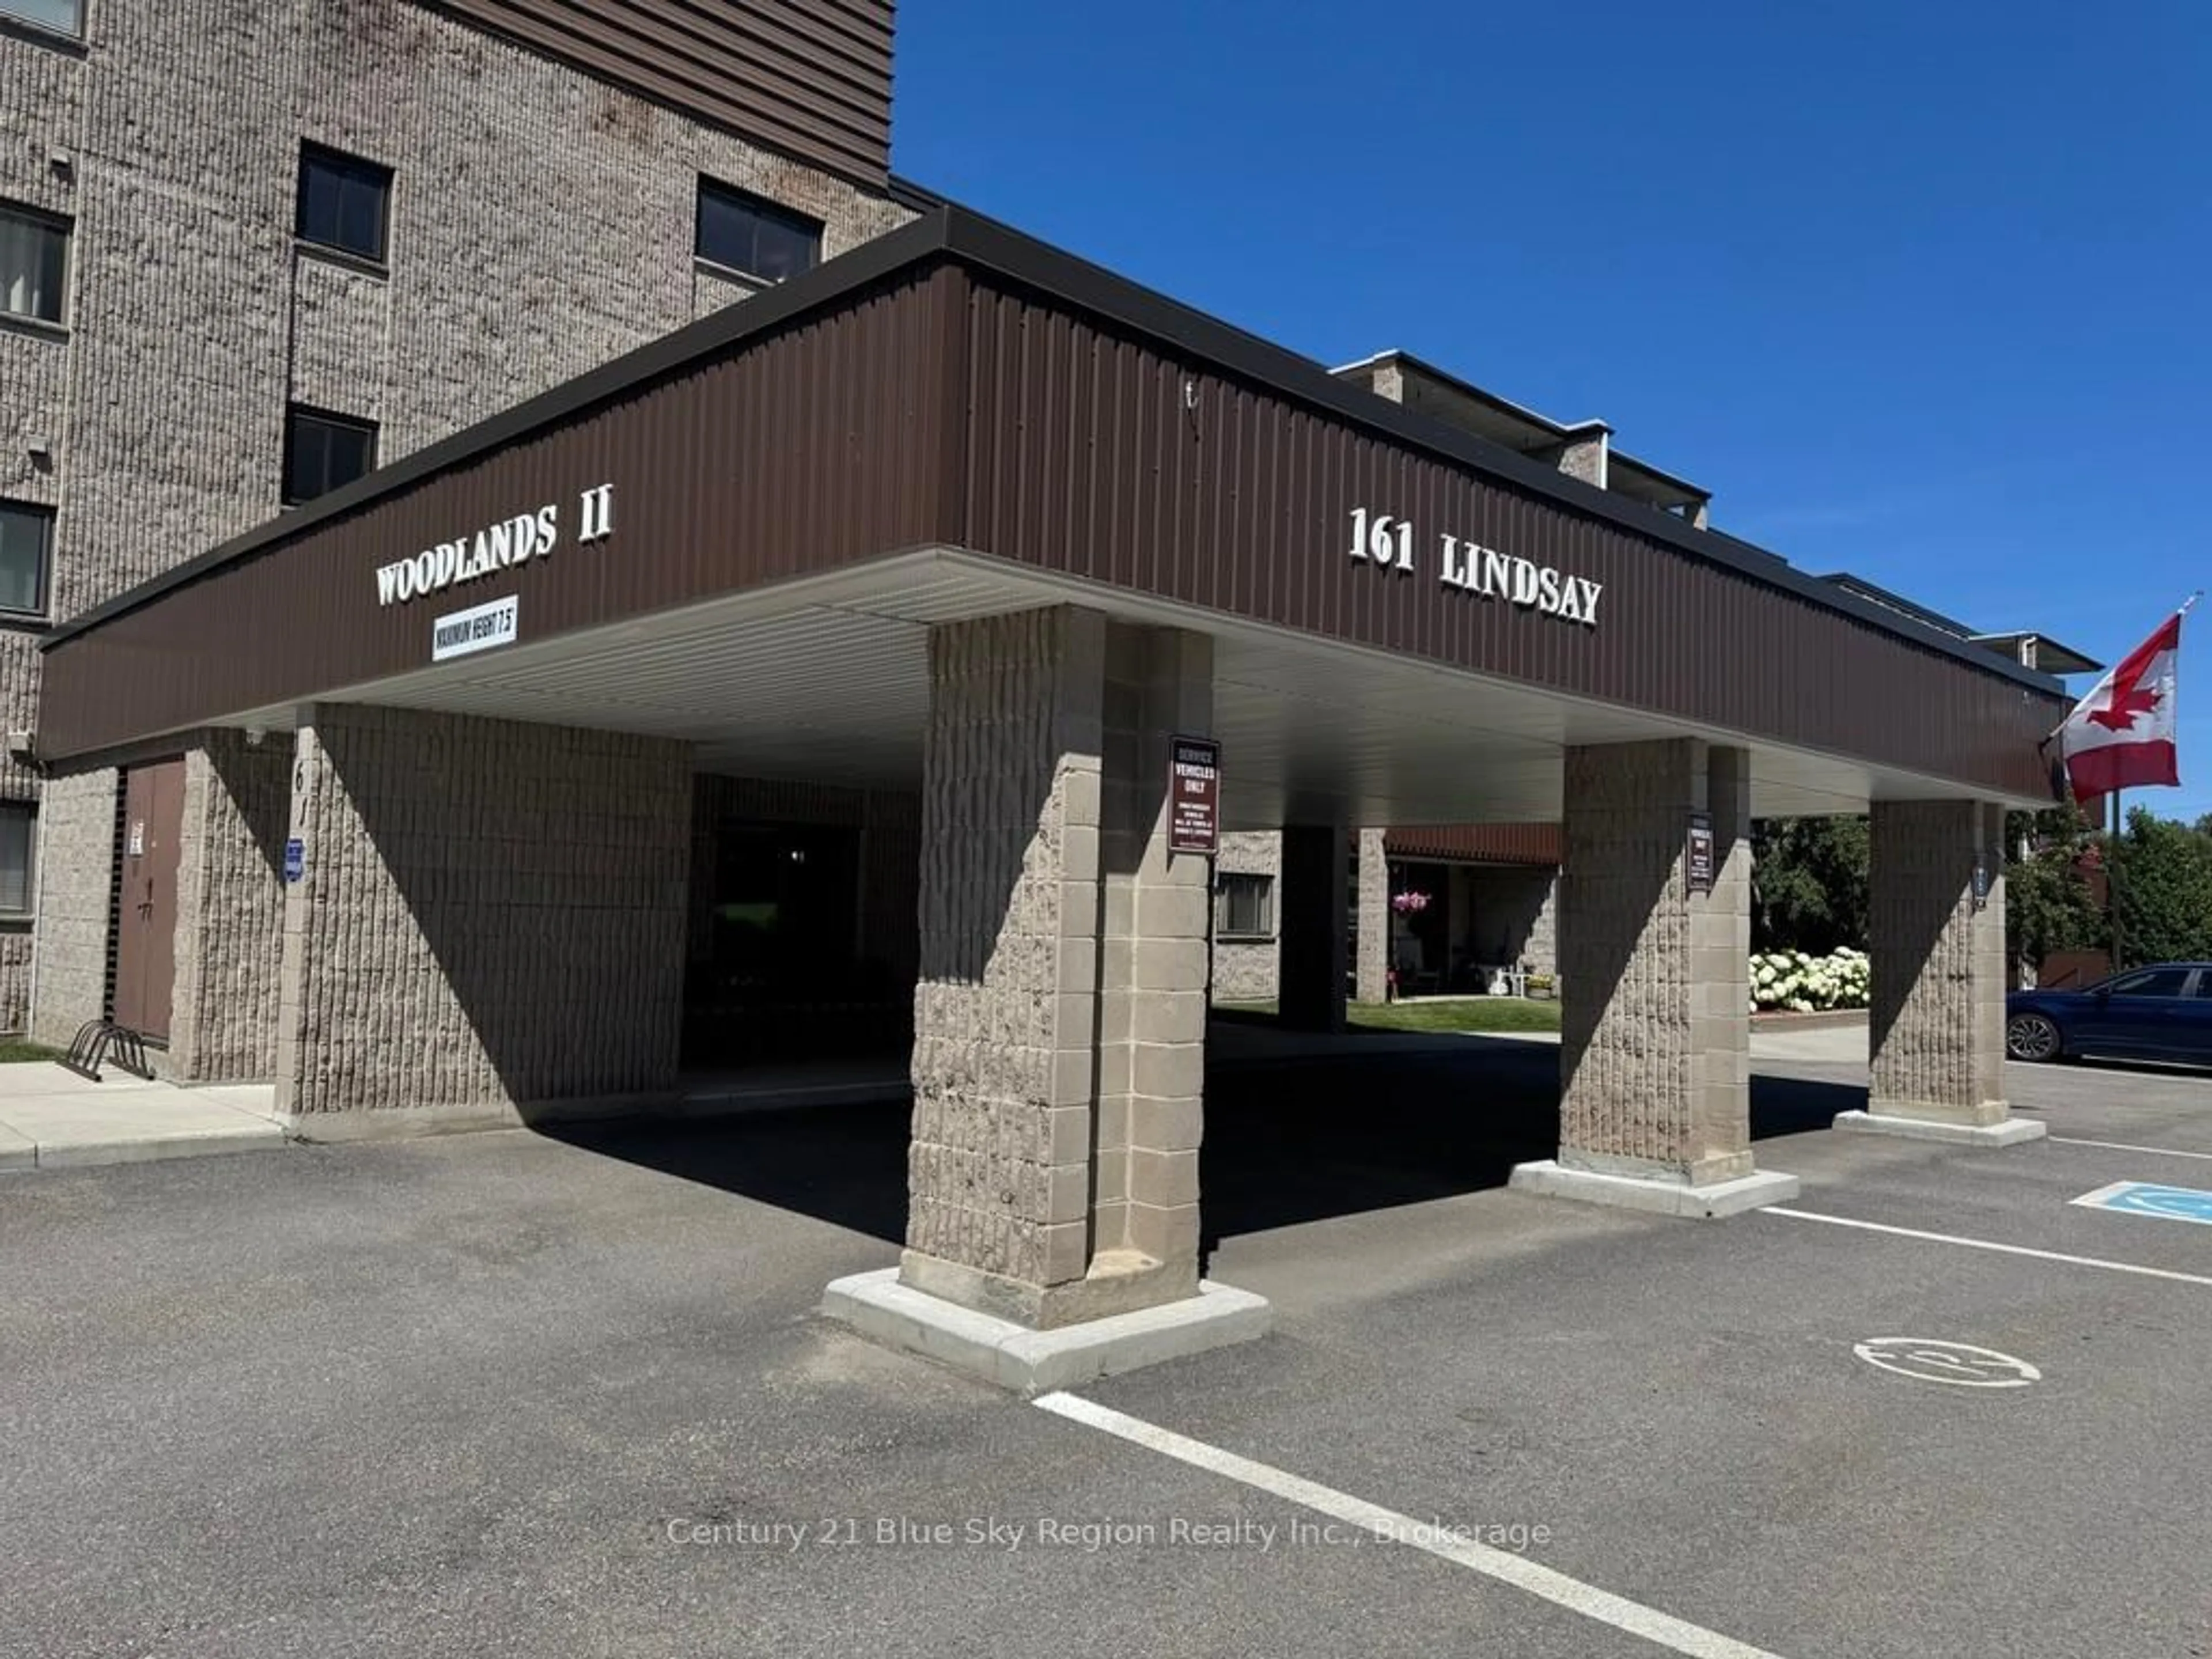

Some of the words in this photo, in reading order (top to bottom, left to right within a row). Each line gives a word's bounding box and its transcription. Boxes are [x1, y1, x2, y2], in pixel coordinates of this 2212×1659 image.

[376, 505, 556, 606] WOODLANDS
[579, 484, 613, 541] II
[1349, 507, 1414, 571] 161
[1440, 533, 1603, 624] LINDSAY
